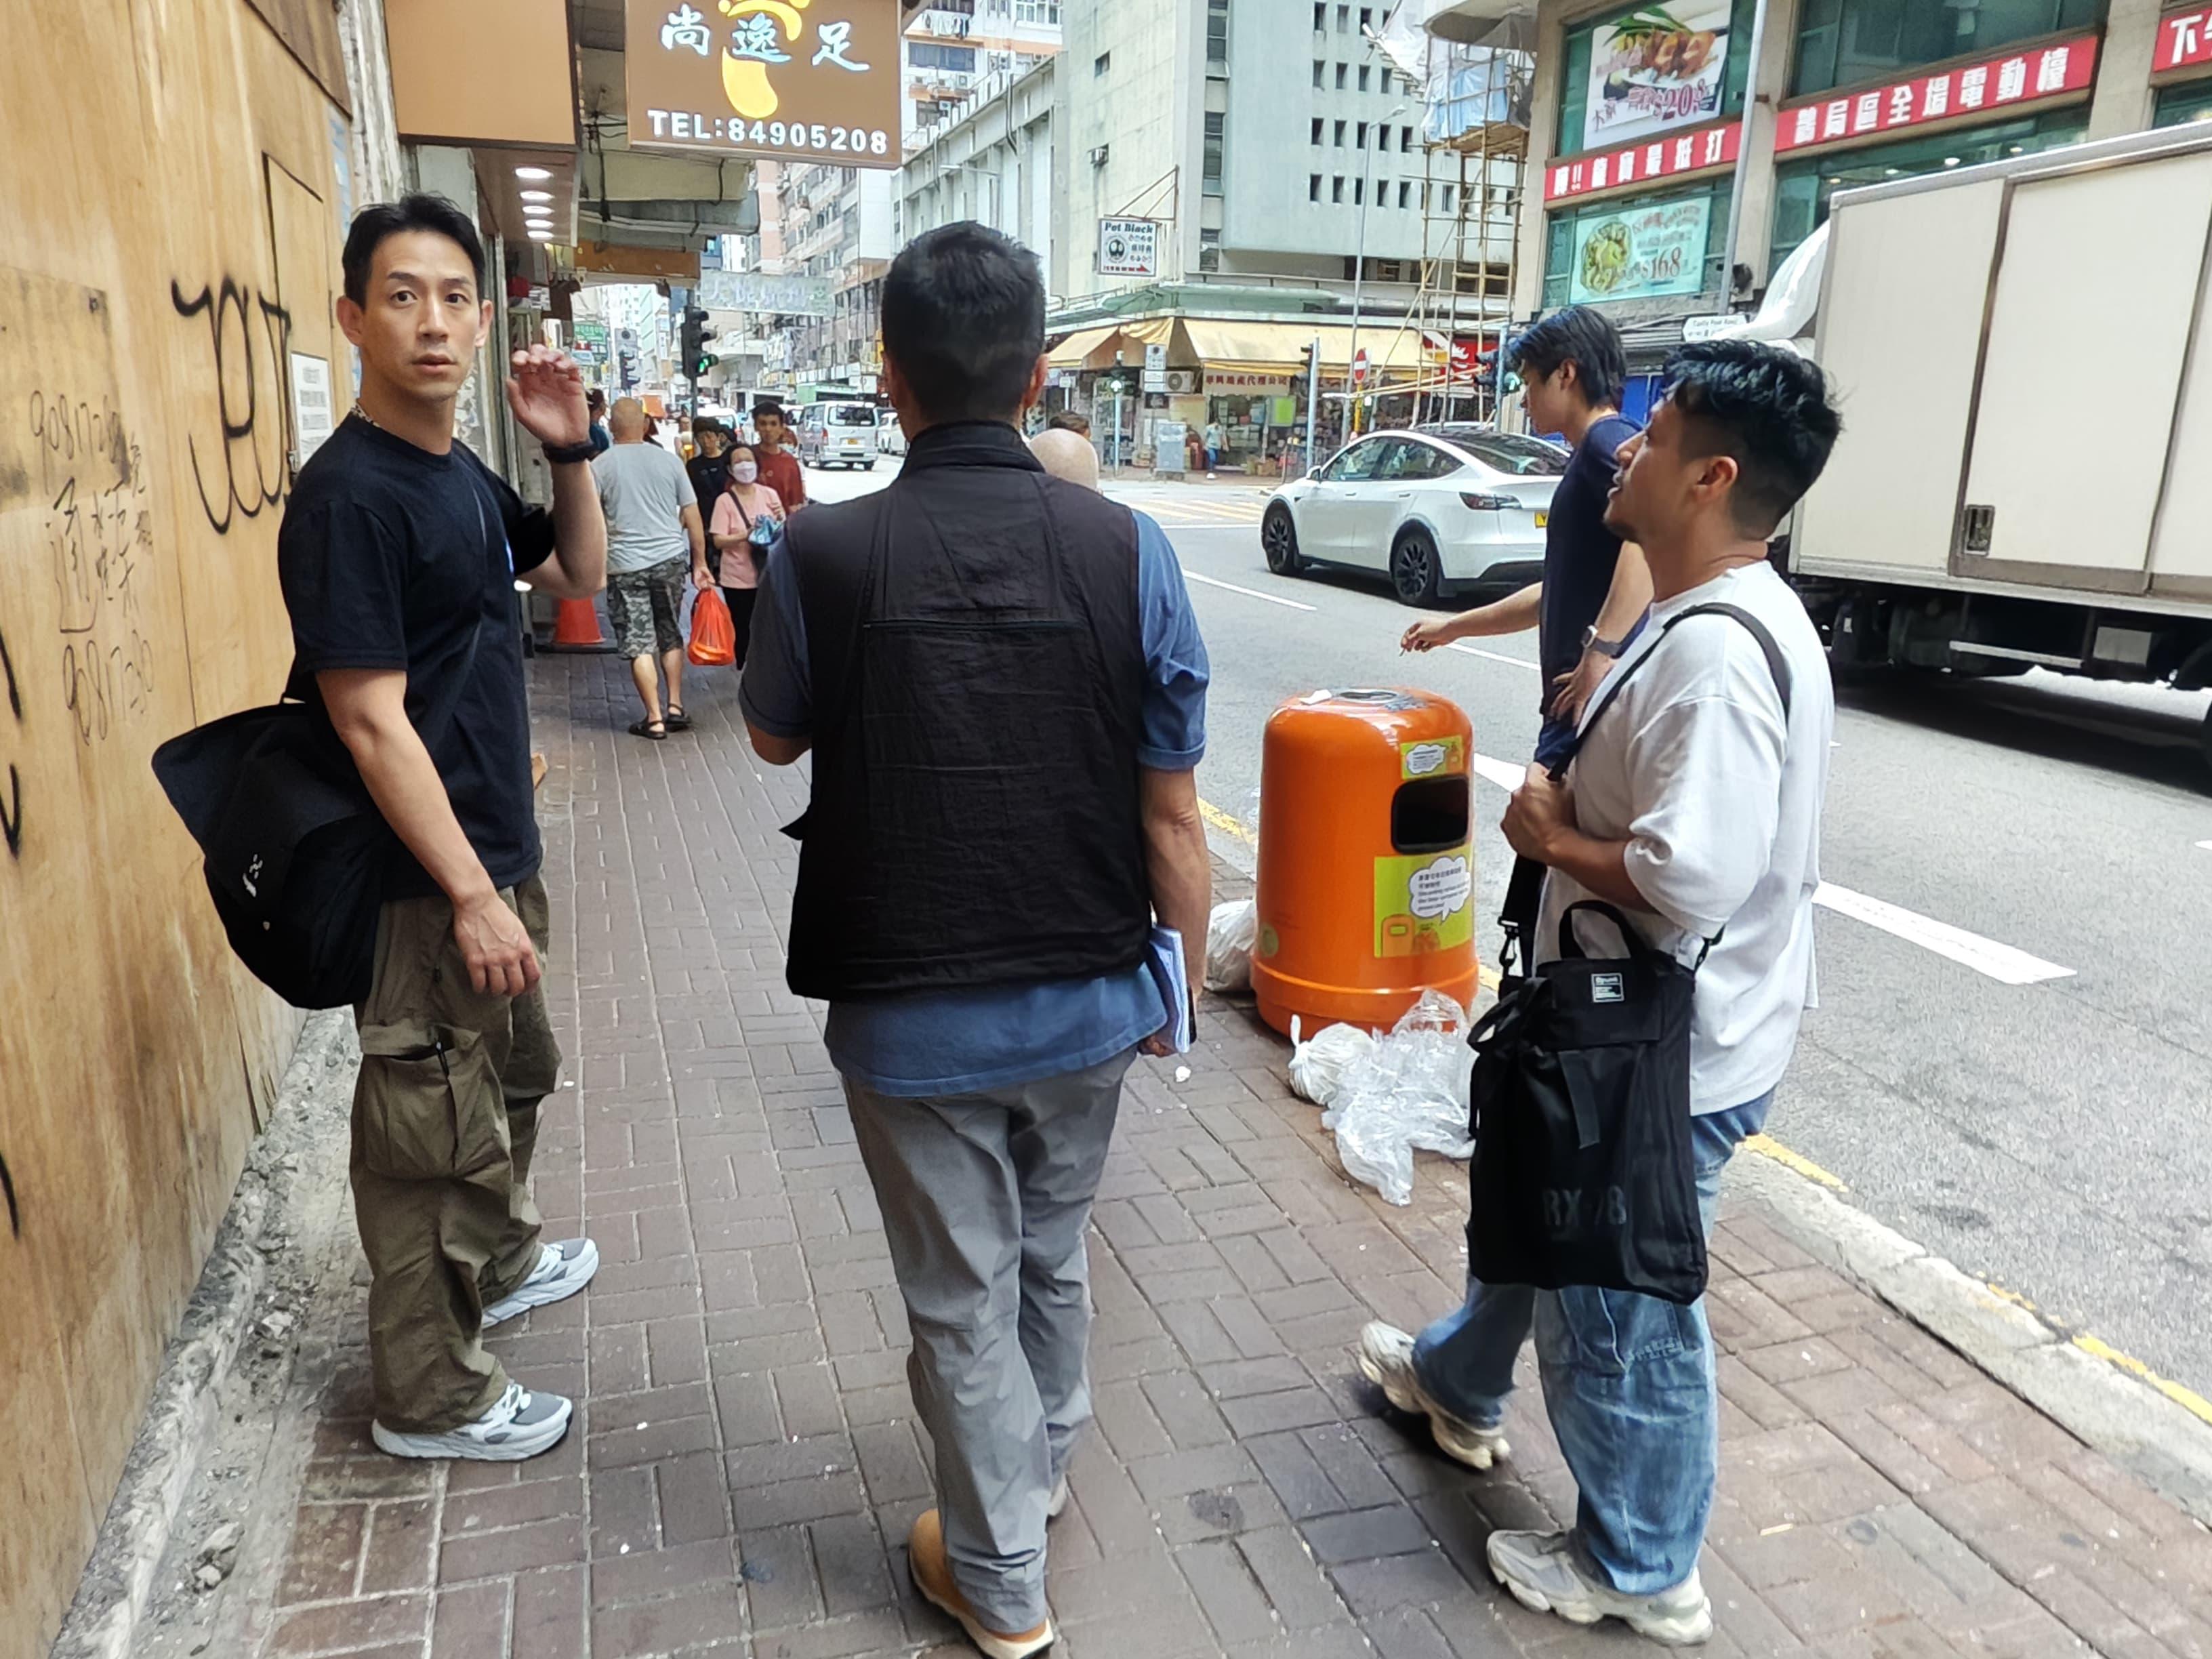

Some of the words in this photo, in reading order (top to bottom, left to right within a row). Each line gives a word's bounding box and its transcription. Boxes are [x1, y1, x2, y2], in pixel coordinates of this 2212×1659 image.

[660, 4, 870, 71] 尚逸足
[2170, 14, 2212, 65] 下
[647, 109, 887, 155] TEL:84905208
